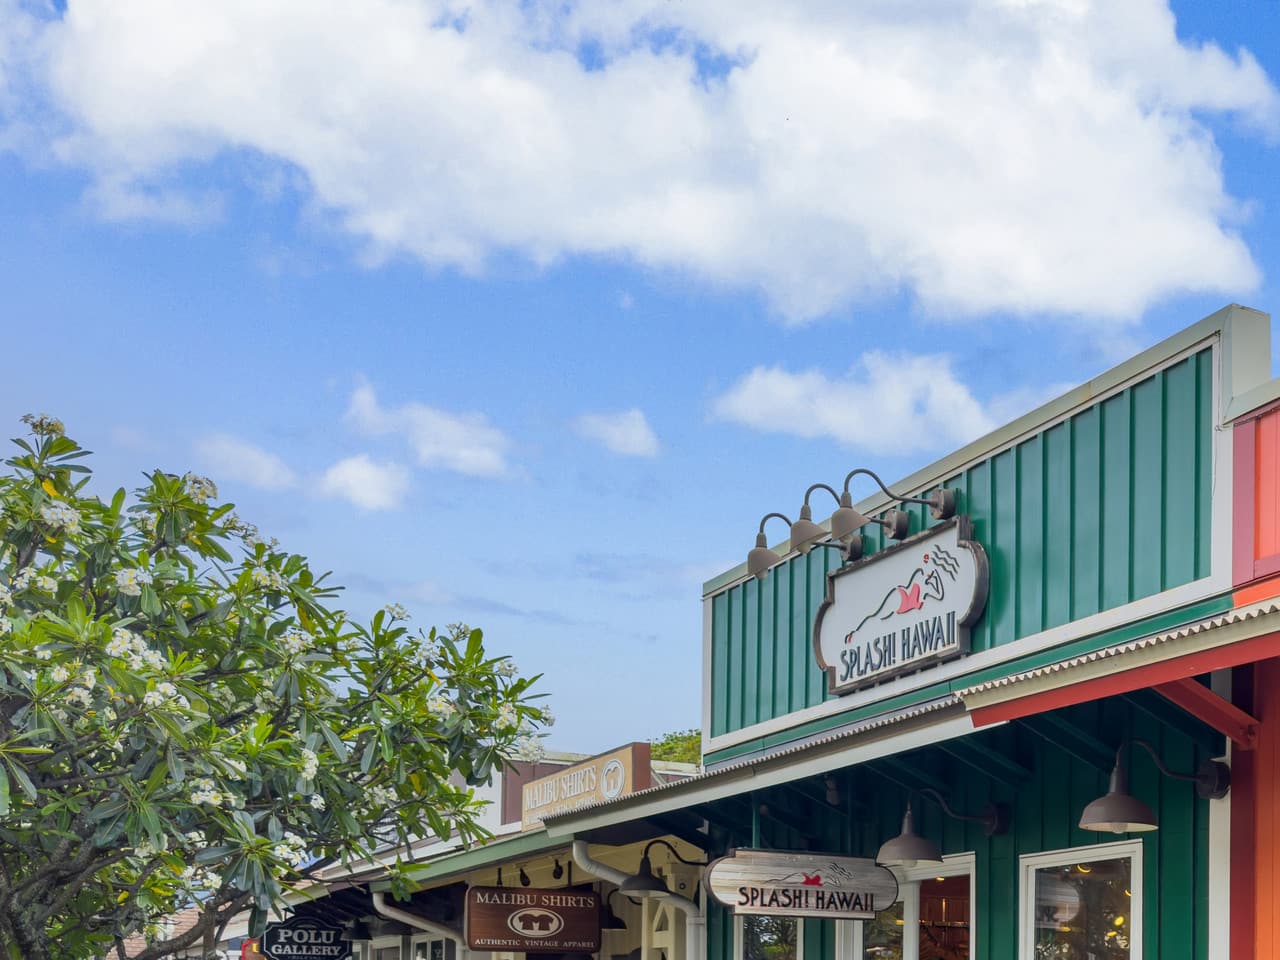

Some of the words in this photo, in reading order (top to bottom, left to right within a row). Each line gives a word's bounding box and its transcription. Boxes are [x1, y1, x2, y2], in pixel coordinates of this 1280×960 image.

[840, 631, 897, 681] SPLASH!
[901, 610, 957, 661] HAWAII
[525, 777, 560, 810] MALIBU
[561, 764, 597, 800] SHIRTS
[476, 892, 537, 906] MALIBU
[541, 895, 595, 908] SHIRTS
[738, 886, 809, 908] SPLASH!
[815, 890, 875, 912] HAWAII
[278, 929, 337, 944] POLU
[474, 938, 521, 947] AUTHENTIC
[525, 940, 559, 948] VINTAGE
[562, 941, 595, 949] APPAREL
[271, 944, 342, 956] GALLERY
